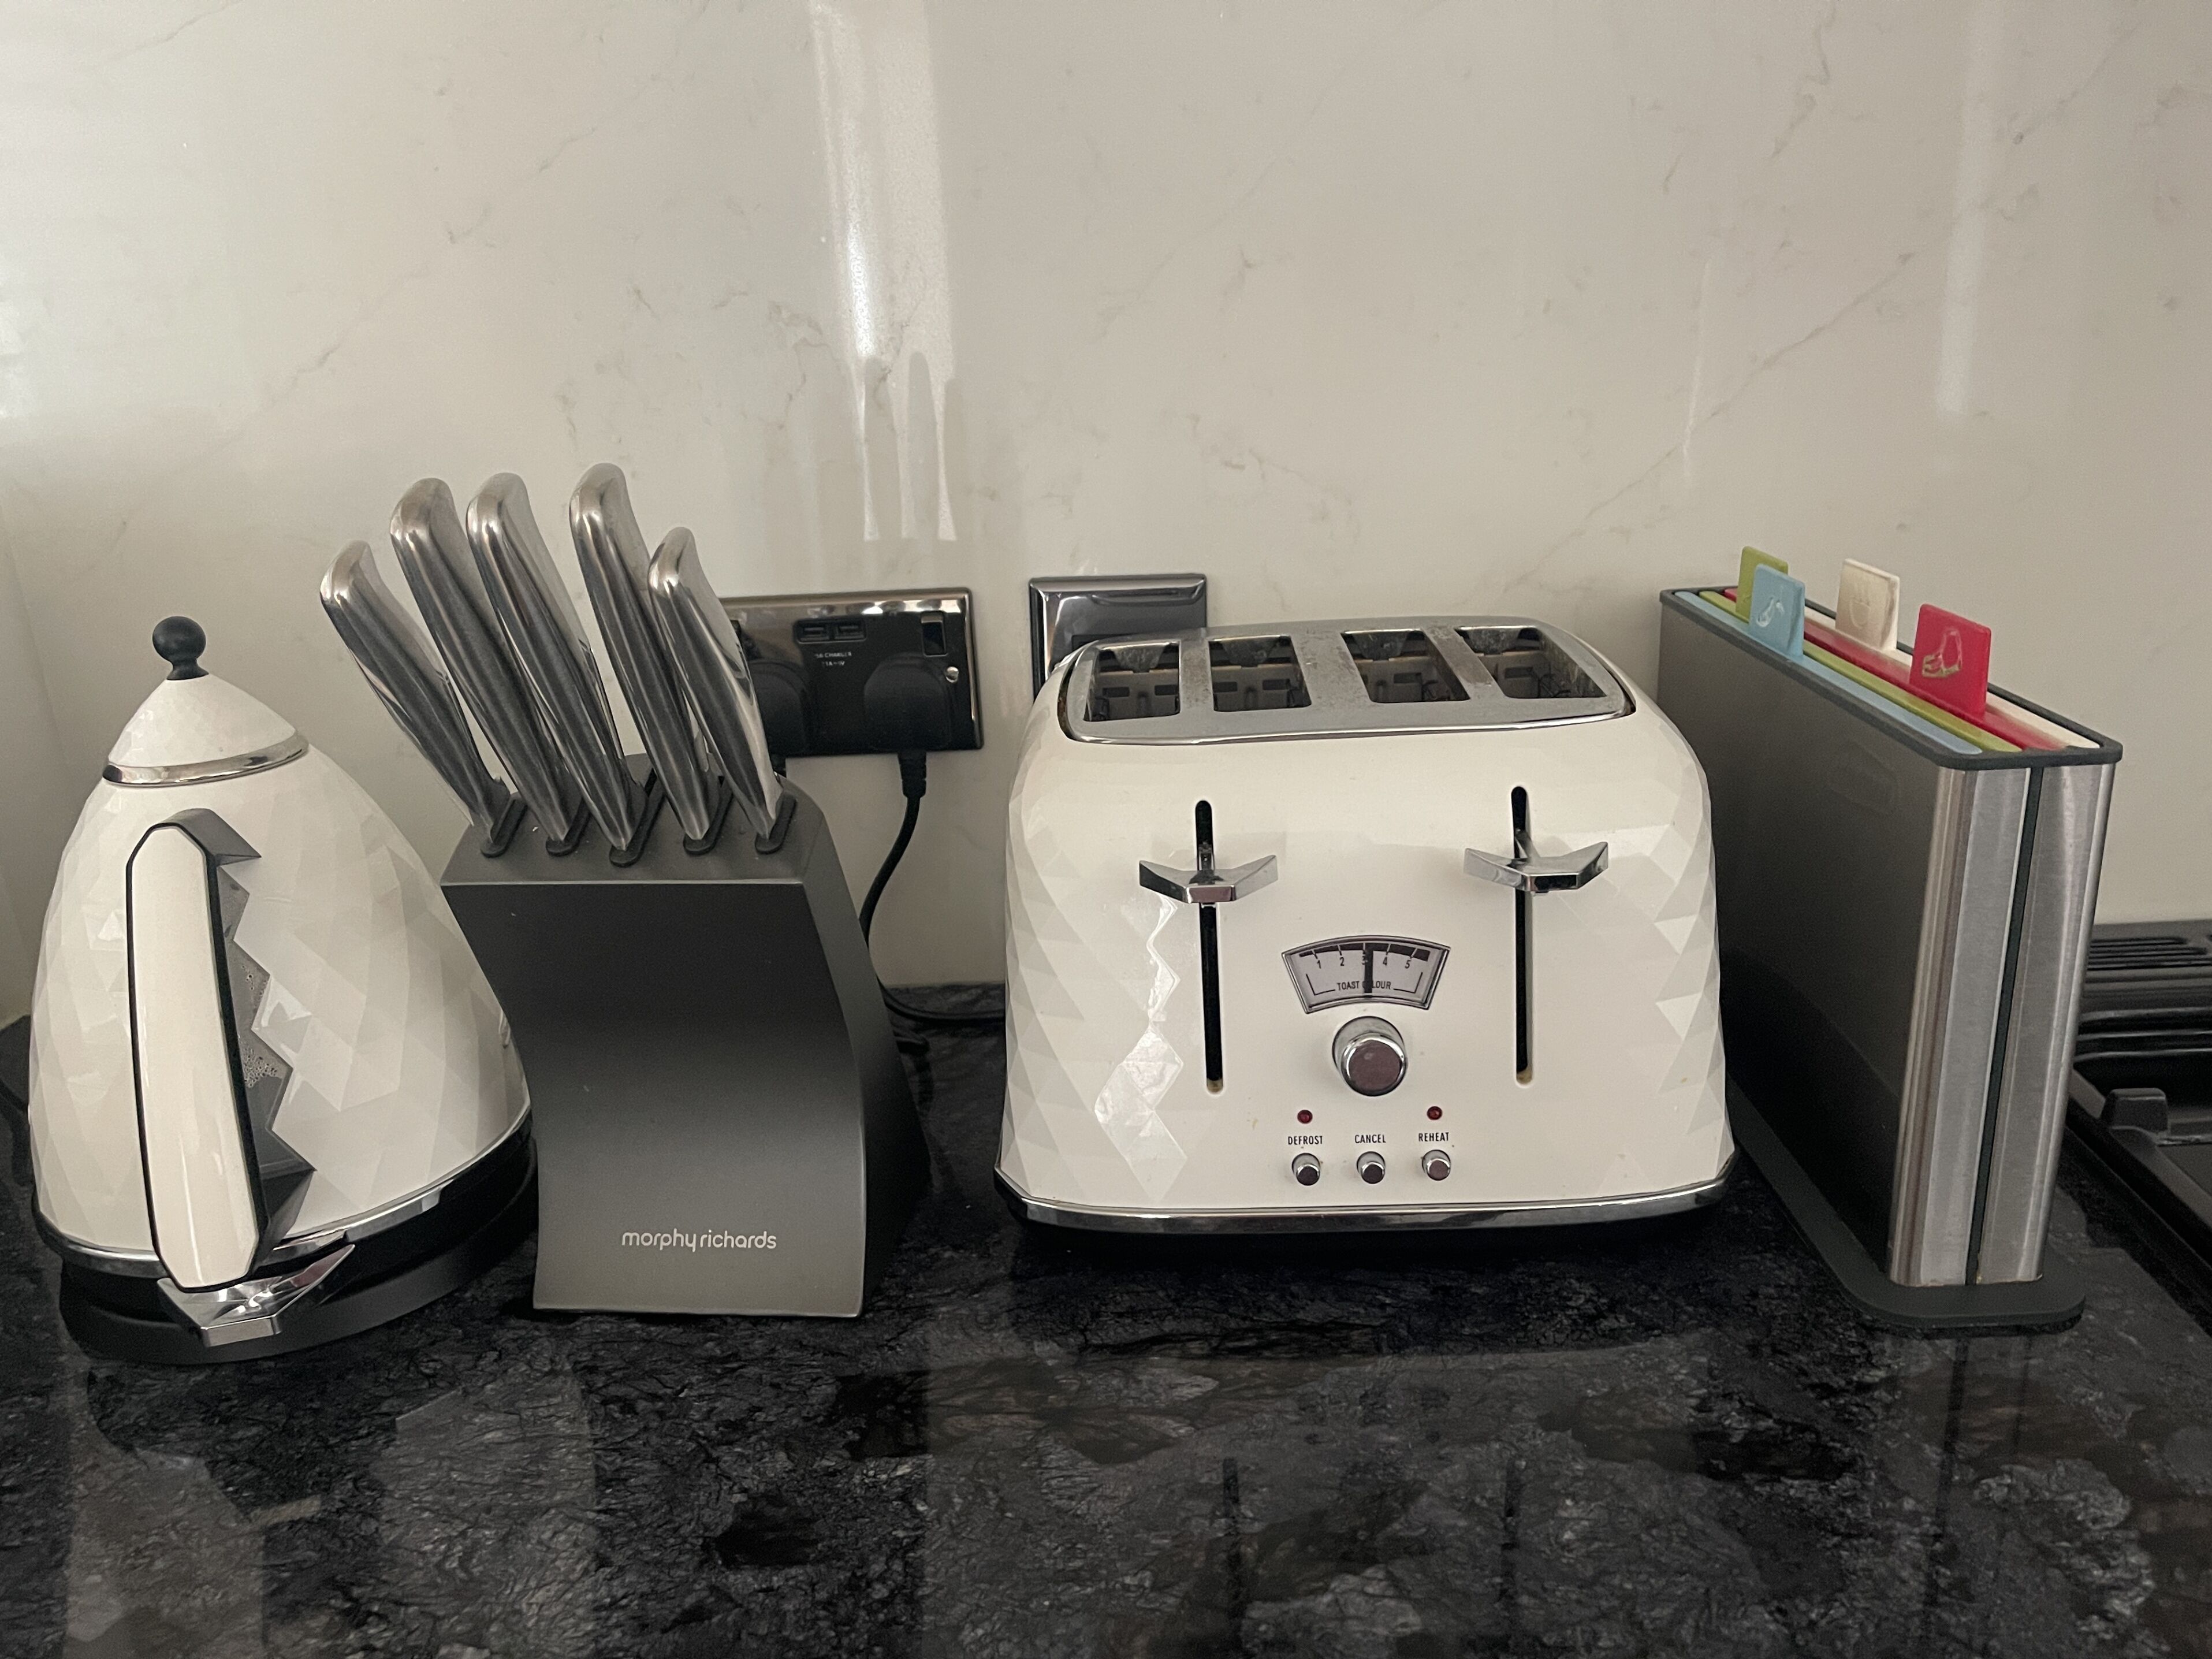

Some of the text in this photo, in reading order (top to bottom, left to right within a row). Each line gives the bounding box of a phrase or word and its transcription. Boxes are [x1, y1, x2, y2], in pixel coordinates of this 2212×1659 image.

[1317, 960, 1321, 969] 1
[1339, 957, 1345, 966] 2
[1383, 956, 1388, 966] 4
[1405, 959, 1412, 969] 5
[1337, 980, 1360, 991] TOAST
[1287, 1135, 1323, 1145] DEFROST
[1354, 1134, 1386, 1144] CANCEL
[1418, 1132, 1450, 1143] REHEAT
[621, 1228, 777, 1252] morphy richards
